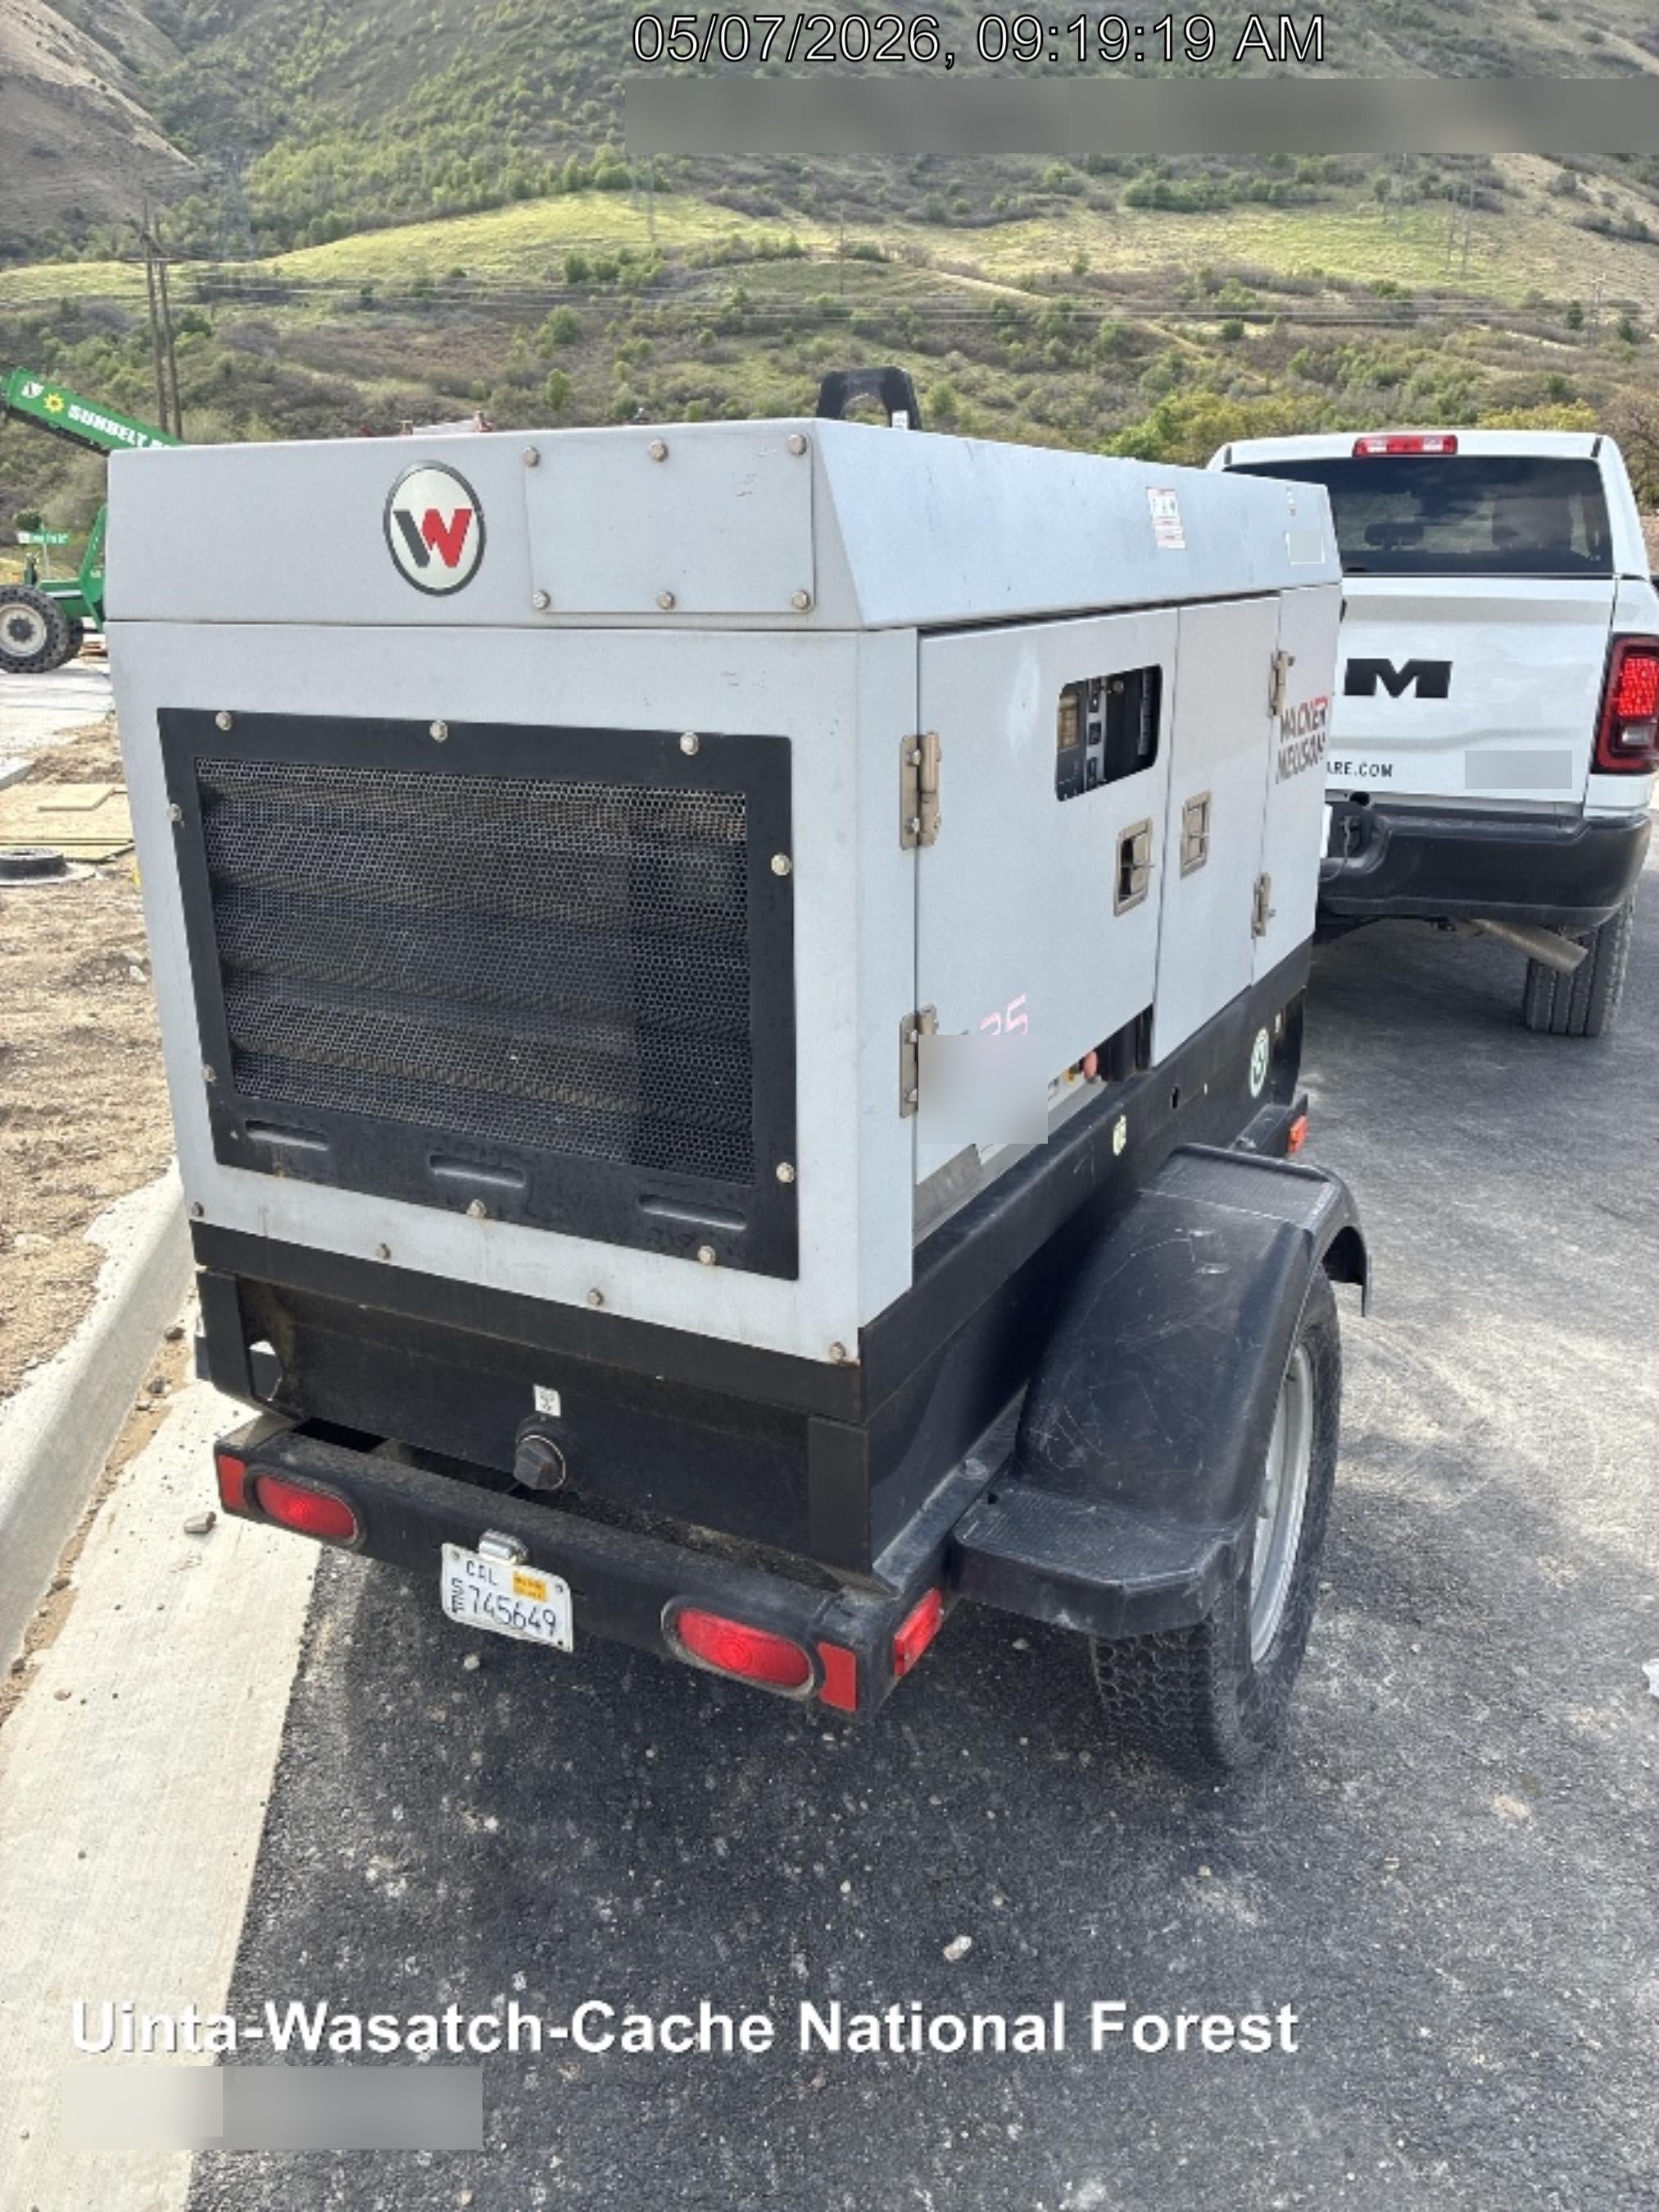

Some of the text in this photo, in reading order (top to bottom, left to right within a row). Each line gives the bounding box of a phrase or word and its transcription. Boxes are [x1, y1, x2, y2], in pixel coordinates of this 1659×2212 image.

[67, 404, 148, 447] SUNBELT
[466, 1560, 498, 1586] CAL
[469, 1584, 557, 1637] 745649
